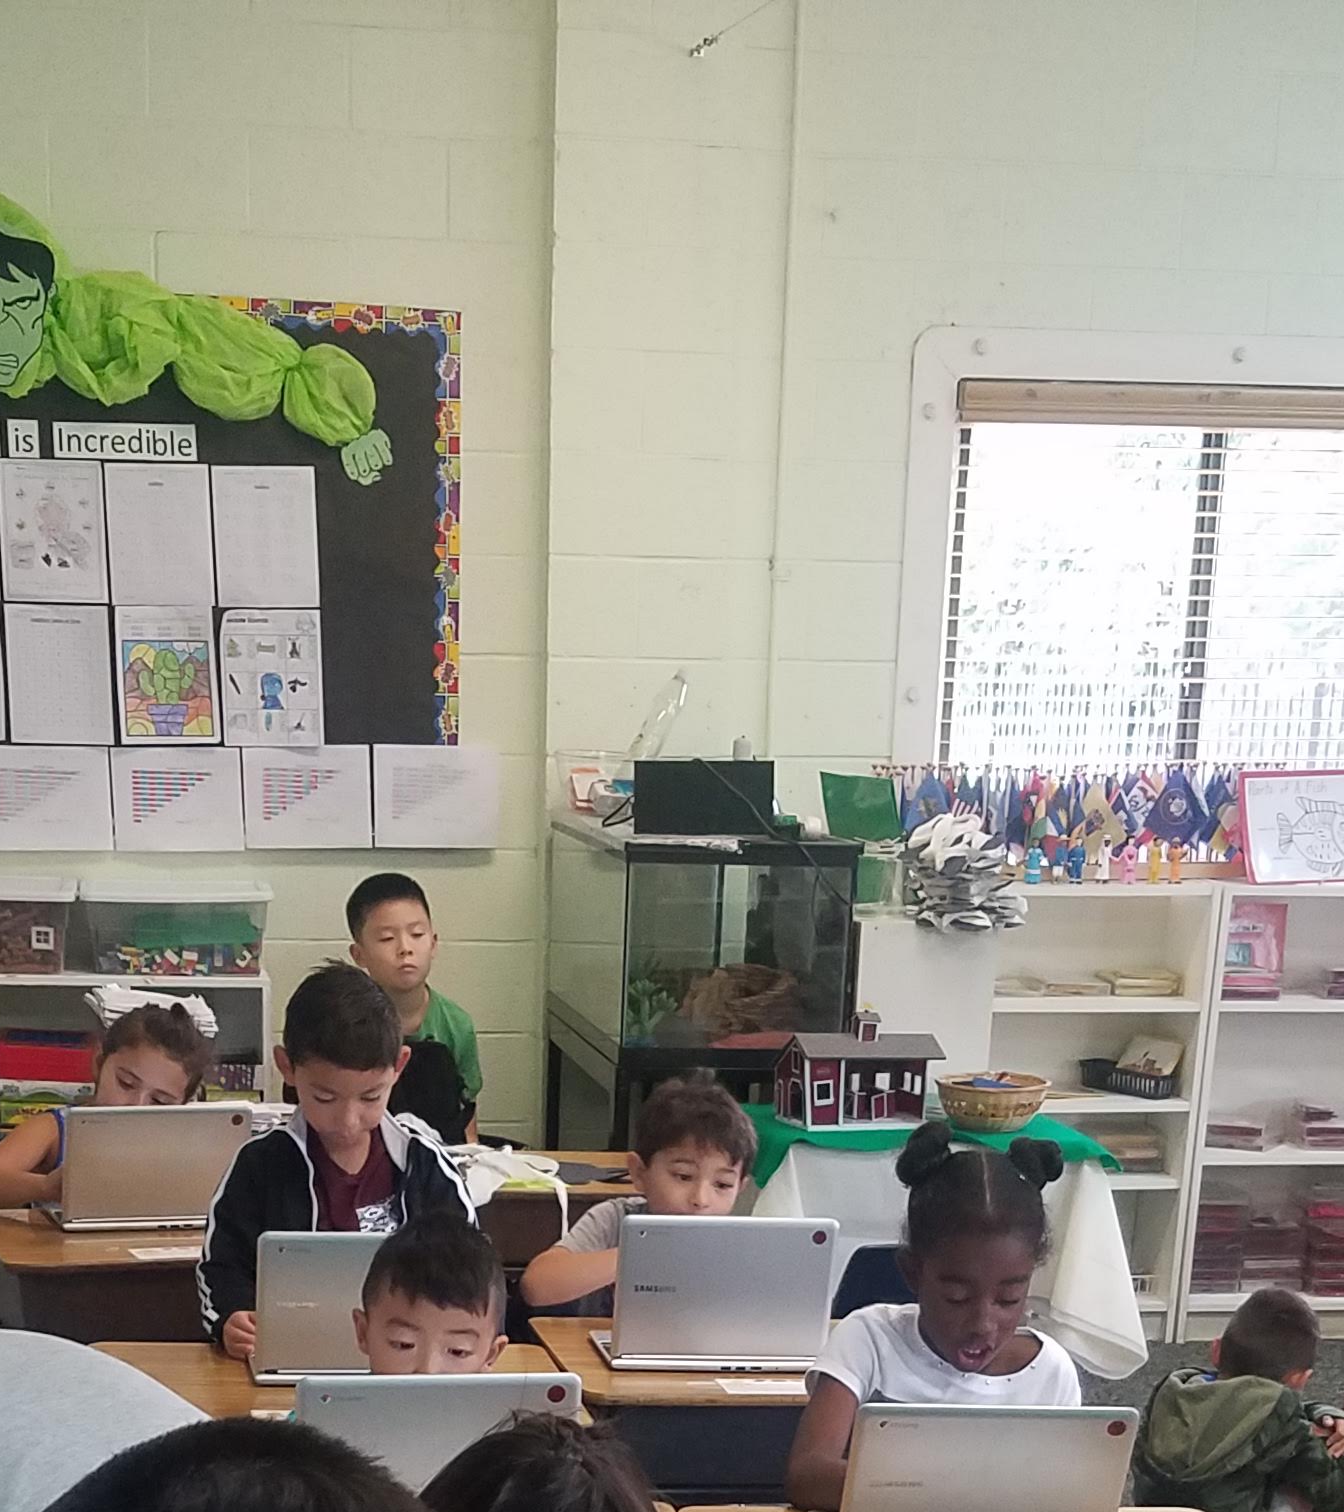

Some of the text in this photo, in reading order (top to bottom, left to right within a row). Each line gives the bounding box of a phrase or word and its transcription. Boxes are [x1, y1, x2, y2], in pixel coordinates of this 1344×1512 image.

[14, 428, 34, 452] is
[58, 429, 193, 456] Incredible
[1306, 780, 1328, 794] Fish
